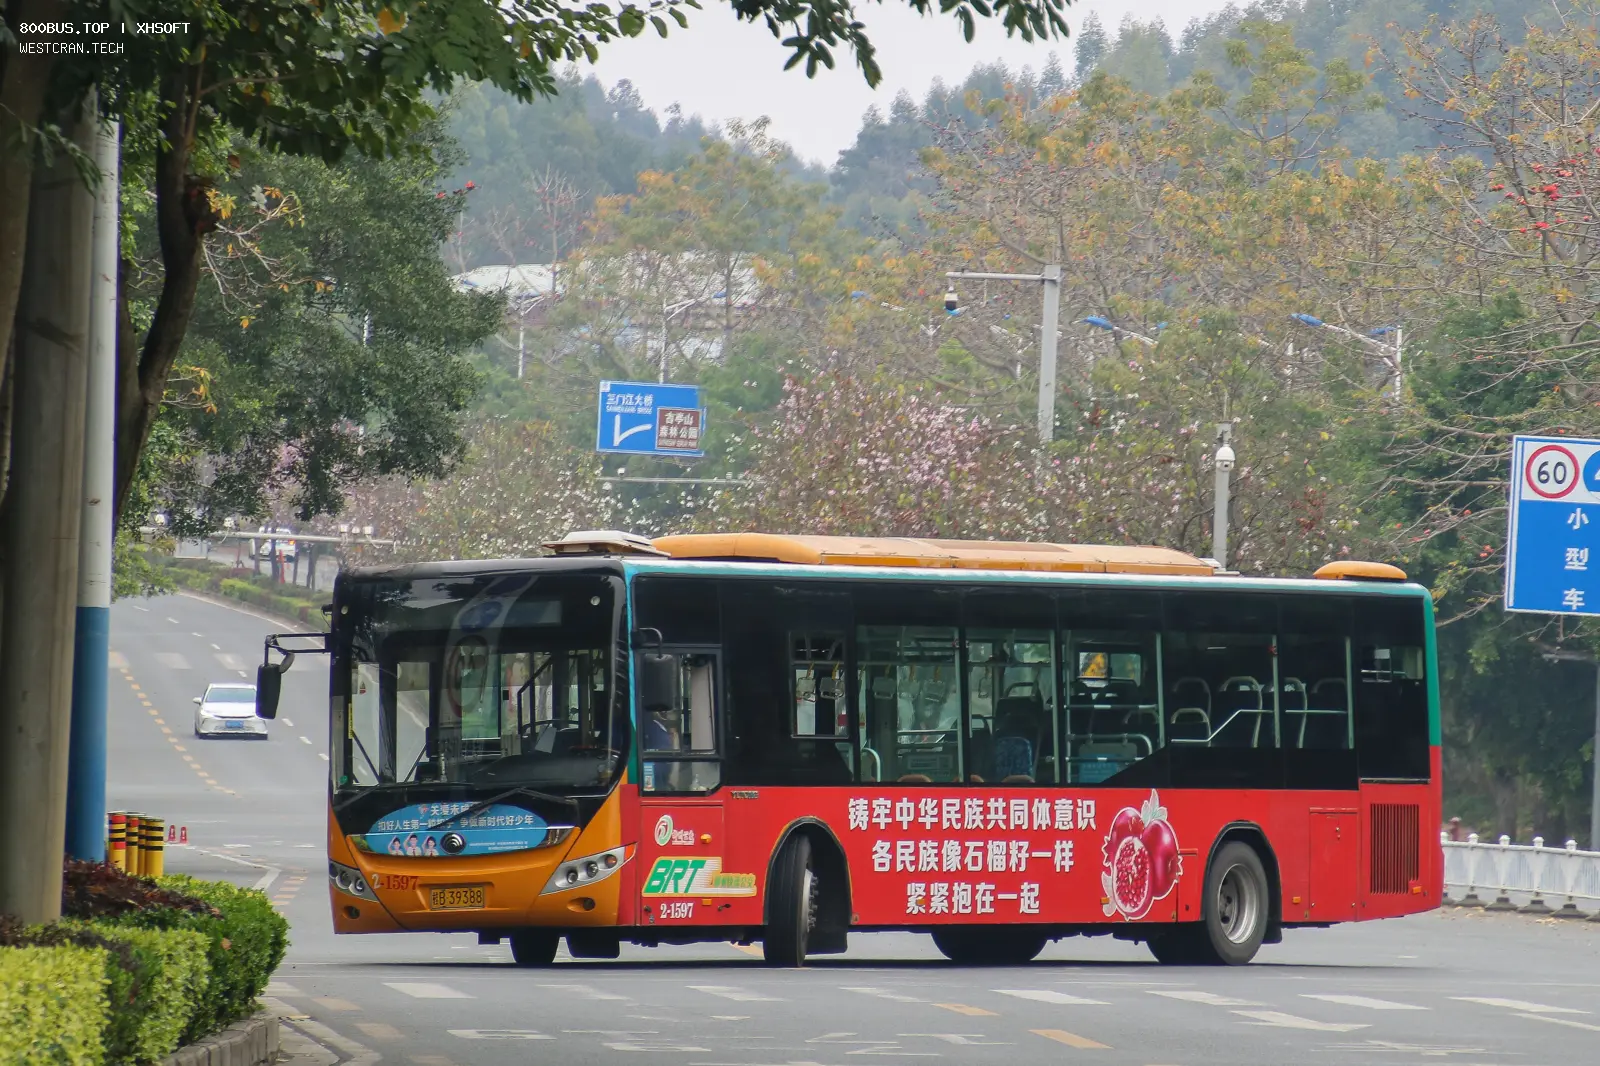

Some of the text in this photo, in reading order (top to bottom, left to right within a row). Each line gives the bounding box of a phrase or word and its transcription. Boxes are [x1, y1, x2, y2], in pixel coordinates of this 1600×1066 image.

[606, 393, 653, 407] 三门江大桥
[659, 425, 699, 440] 森林公园
[1537, 461, 1567, 485] 60
[1562, 507, 1590, 611] 小型车
[848, 797, 1097, 831] 铸牢中华民族共同体意识
[872, 839, 1075, 873] 各民族像石榴籽一样
[371, 873, 419, 891] 2-1597
[643, 859, 707, 894] BRT
[660, 902, 694, 919] 2-1597
[906, 882, 1041, 915] 紧紧抱在一起
